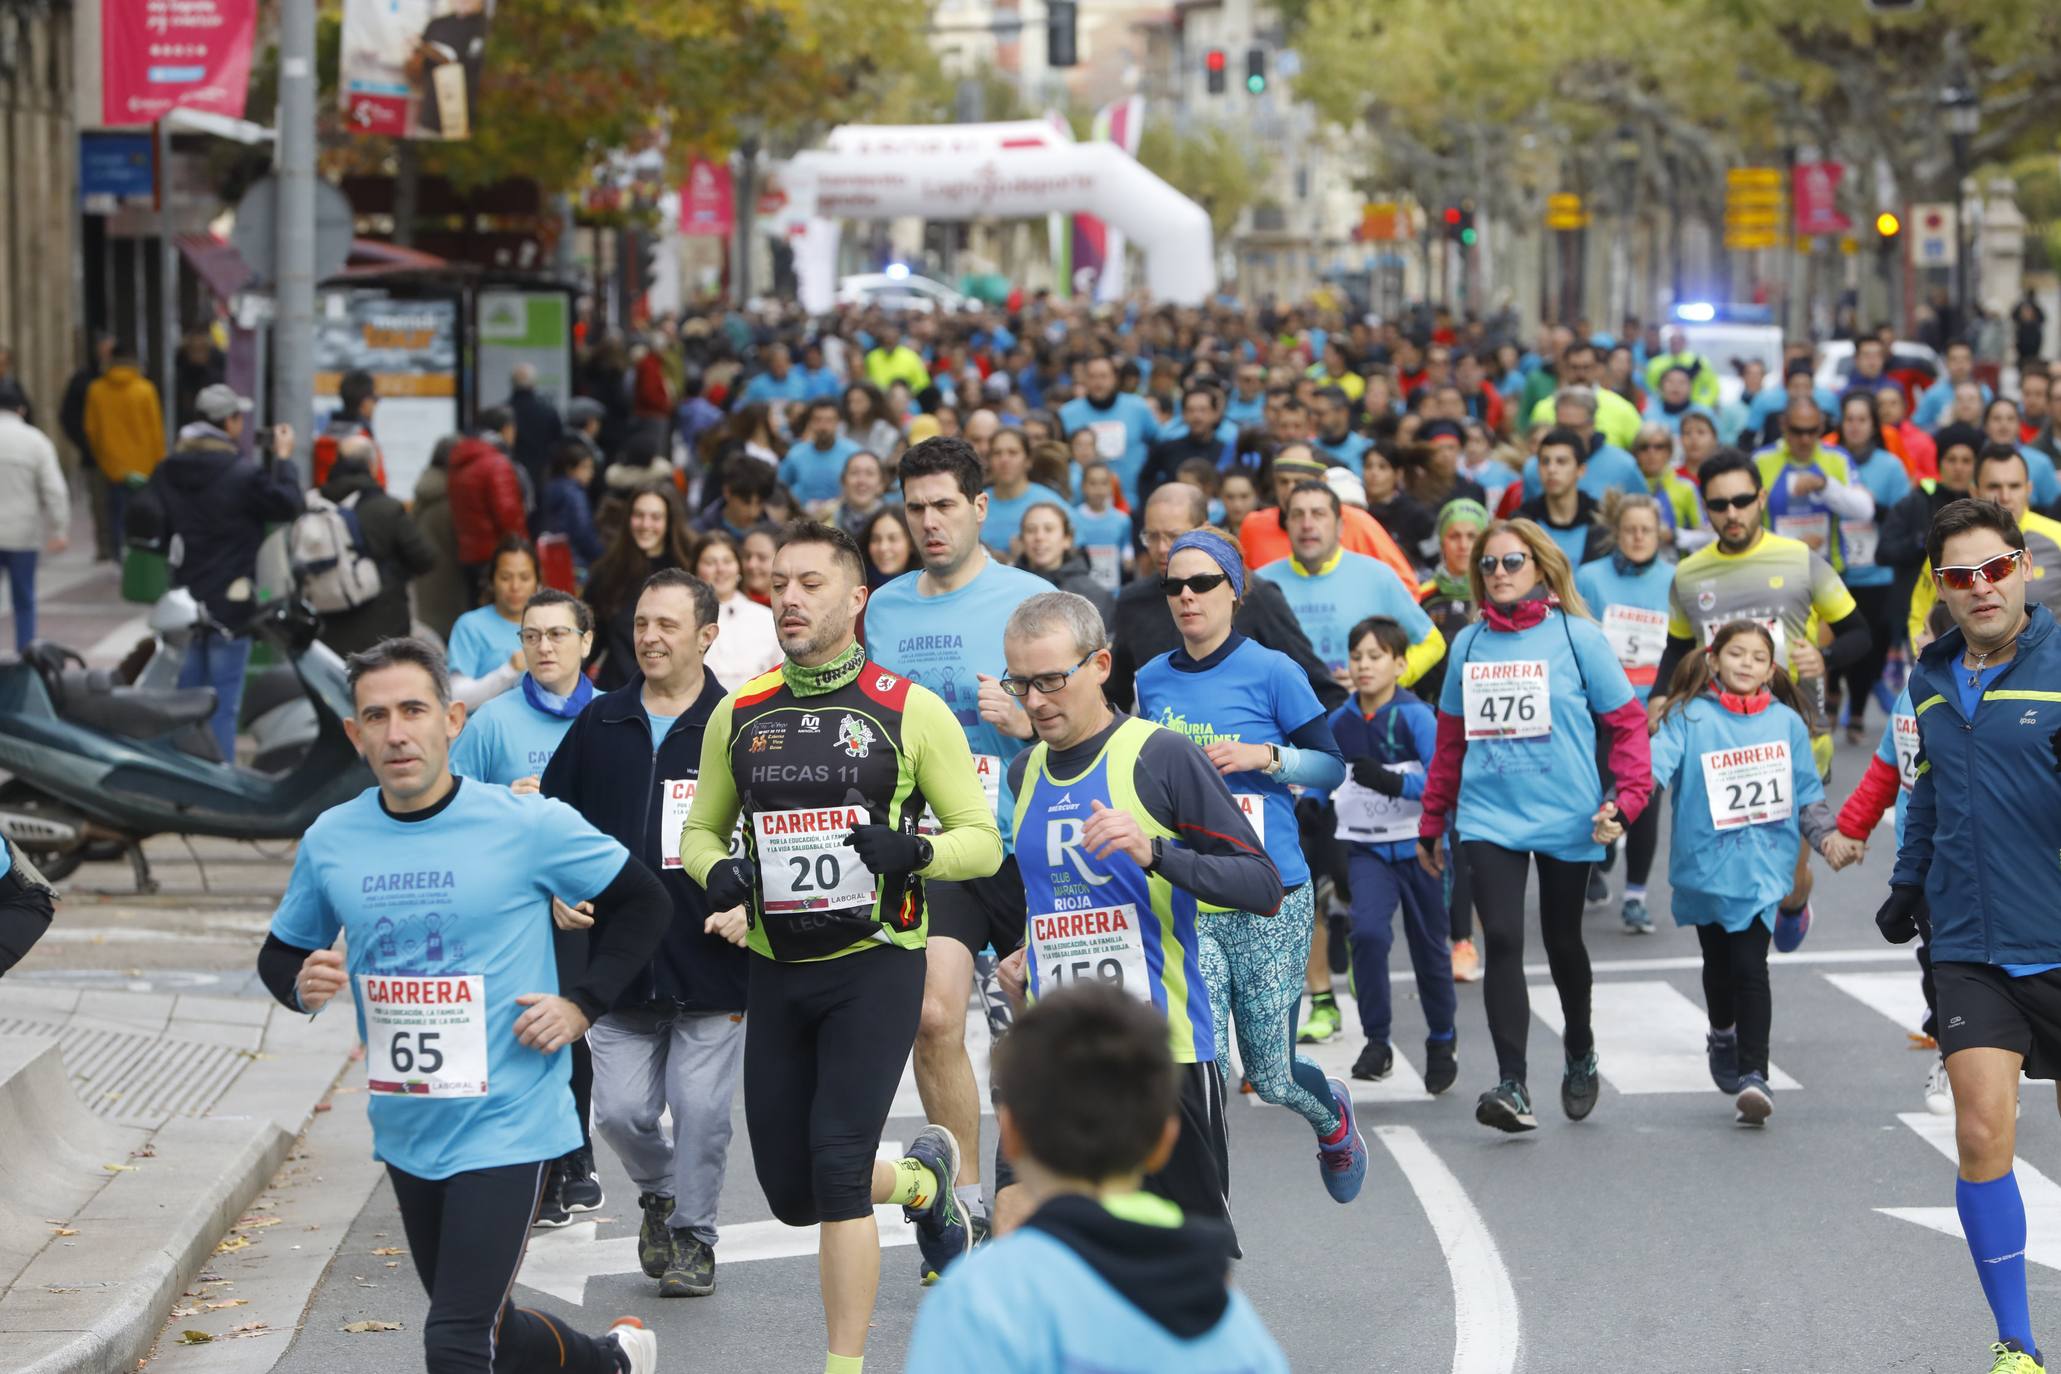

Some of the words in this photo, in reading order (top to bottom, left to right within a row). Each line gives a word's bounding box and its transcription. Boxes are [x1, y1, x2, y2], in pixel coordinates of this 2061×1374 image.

[899, 635, 963, 652] CARRERA
[1625, 636, 1639, 655] 5
[1471, 664, 1543, 680] CARRERA
[1480, 695, 1535, 722] 476
[1711, 744, 1785, 769] CARRERA
[752, 765, 829, 783] HECAS
[838, 766, 859, 783] 11
[1726, 778, 1784, 810] 221
[1048, 803, 1080, 812] MERCURY
[763, 809, 859, 835] CARRERA
[791, 843, 824, 851] SALUDABLE
[362, 871, 455, 893] CARRERA
[789, 854, 840, 892] 20
[1050, 872, 1071, 884] CLUB
[831, 892, 866, 903] LABORAL
[1054, 896, 1092, 911] RIOJA
[1035, 910, 1128, 941] CARRERA
[1110, 943, 1130, 951] RIOJA
[1051, 958, 1124, 989] 159
[367, 980, 472, 1004] CARRERA
[391, 1031, 443, 1074] 65
[432, 1082, 473, 1090] LABORAL
